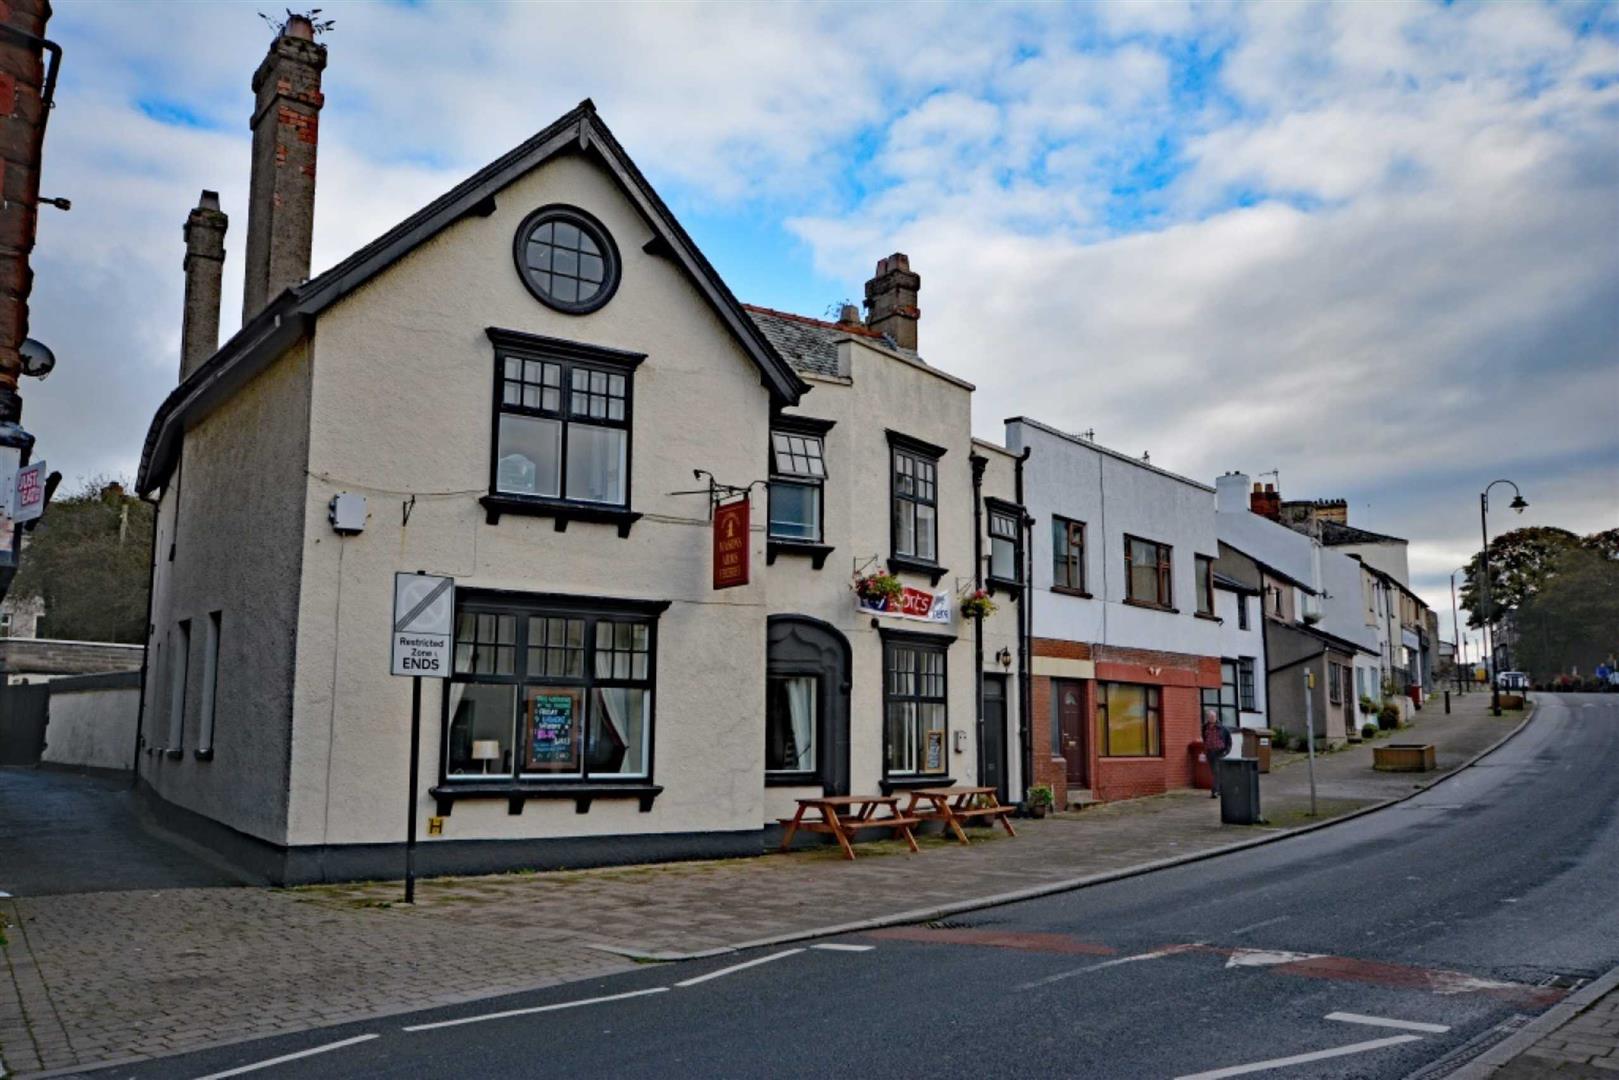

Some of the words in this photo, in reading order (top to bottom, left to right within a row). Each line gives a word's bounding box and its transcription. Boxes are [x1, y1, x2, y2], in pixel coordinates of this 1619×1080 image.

[18, 471, 38, 490] JUST
[400, 637, 444, 647] Restricted
[411, 648, 432, 657] Zone
[402, 657, 439, 670] ENDS
